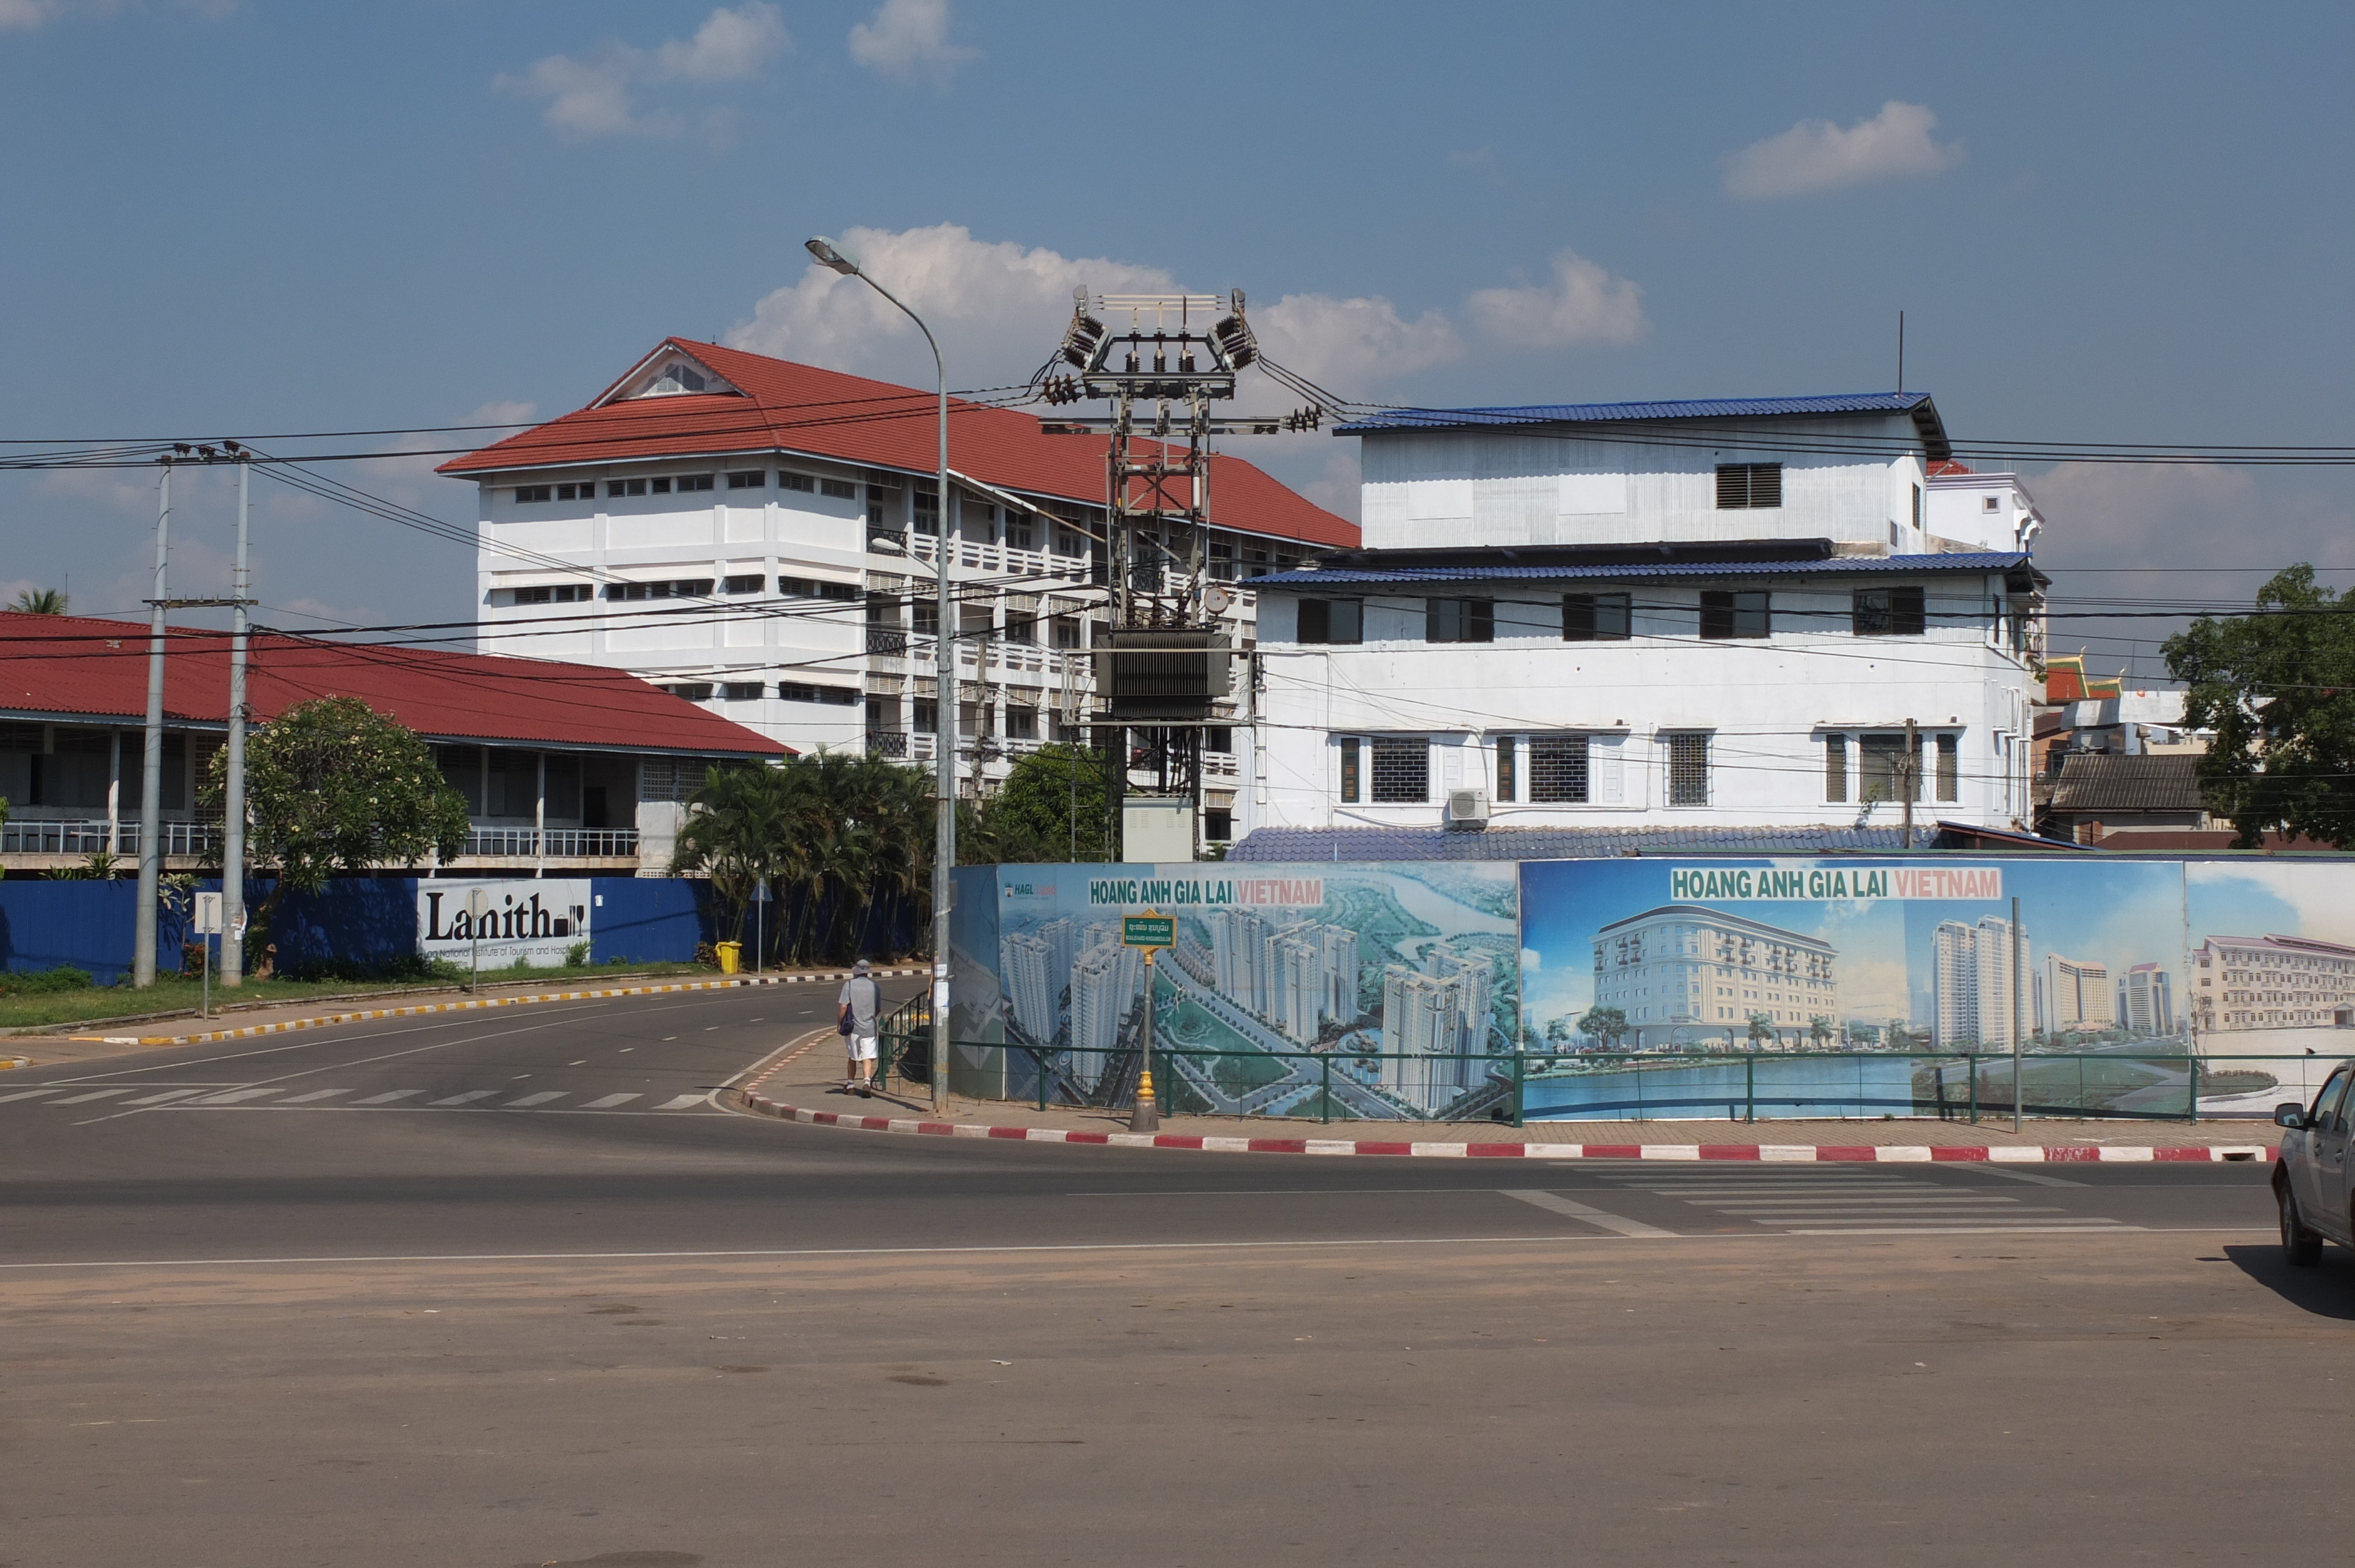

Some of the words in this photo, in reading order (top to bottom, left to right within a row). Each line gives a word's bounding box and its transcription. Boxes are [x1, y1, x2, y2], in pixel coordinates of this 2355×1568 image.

[1014, 884, 1033, 895] HAGL
[1090, 880, 1137, 904] HOANG
[1140, 880, 1171, 904] ANH
[1175, 880, 1202, 904] GIA
[1205, 880, 1232, 904] LAI
[1237, 880, 1321, 904] VIETNAM
[1673, 870, 1752, 898] HOANG
[1757, 871, 1804, 898] ANH
[1809, 870, 1847, 898] GIA
[1853, 870, 1887, 898] LAI
[1894, 870, 1998, 898] VIETNAM
[425, 892, 552, 940] Lanith
[440, 948, 470, 958] National
[472, 946, 498, 957] Istitute
[500, 946, 508, 956] of
[509, 946, 534, 956] Tourism
[536, 945, 549, 955] and
